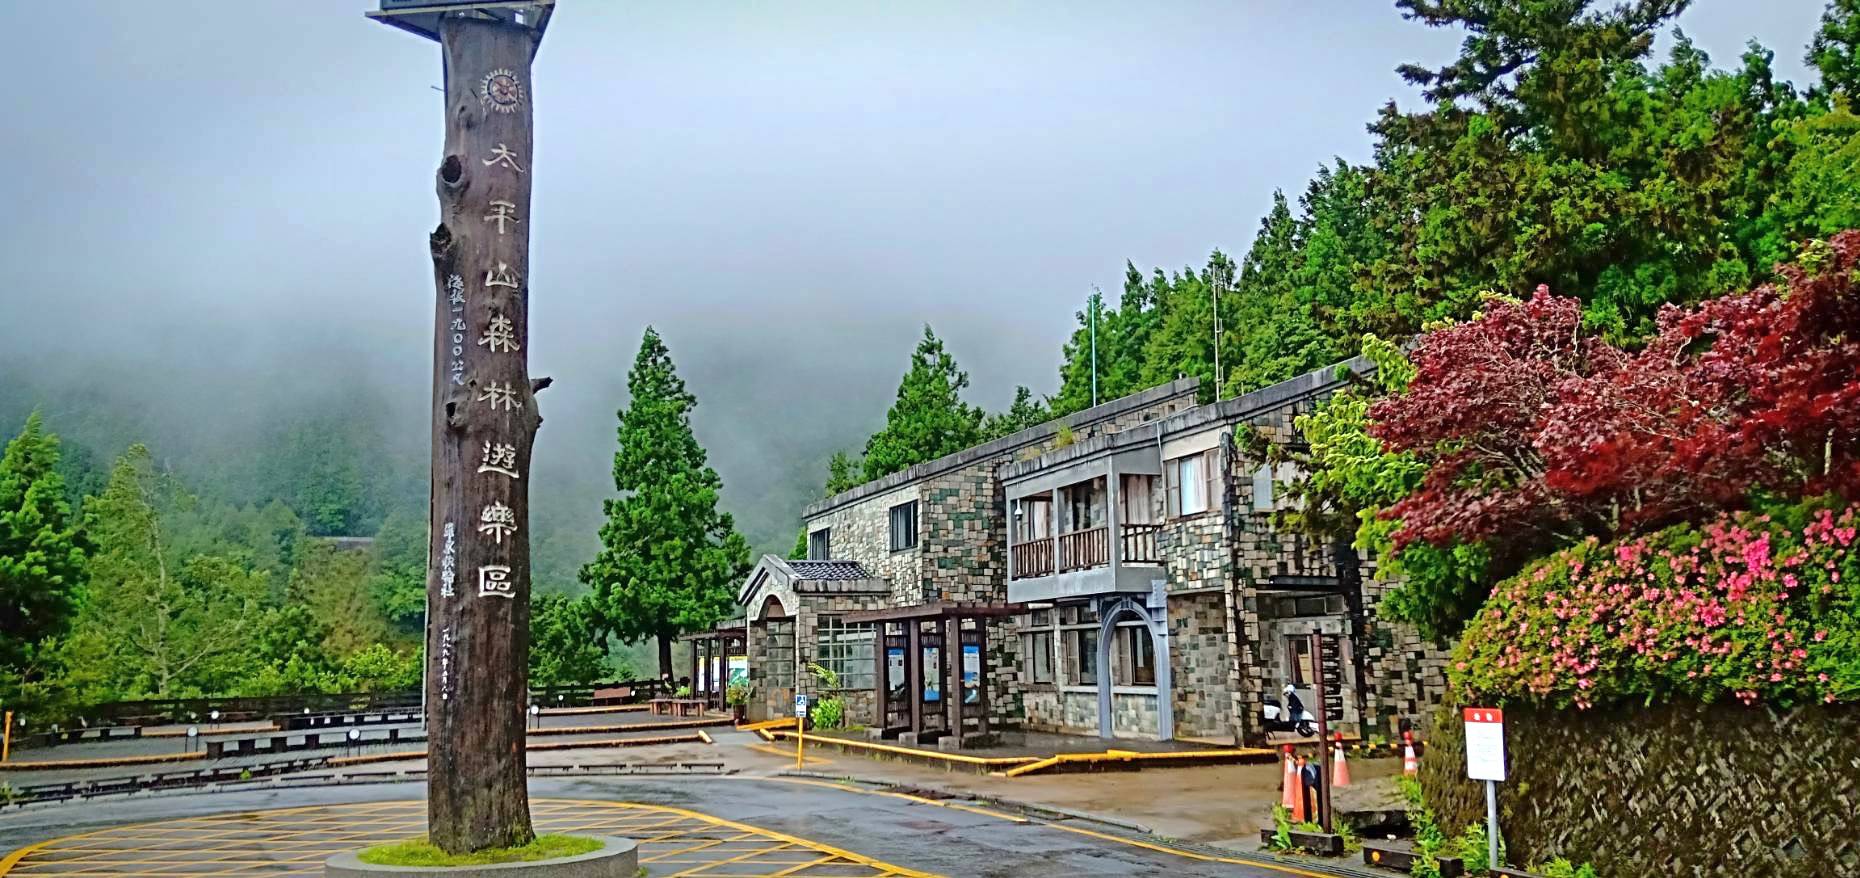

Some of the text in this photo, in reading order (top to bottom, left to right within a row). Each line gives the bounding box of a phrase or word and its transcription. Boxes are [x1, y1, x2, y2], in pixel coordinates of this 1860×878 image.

[477, 143, 524, 599] 太平山森林遊樂區
